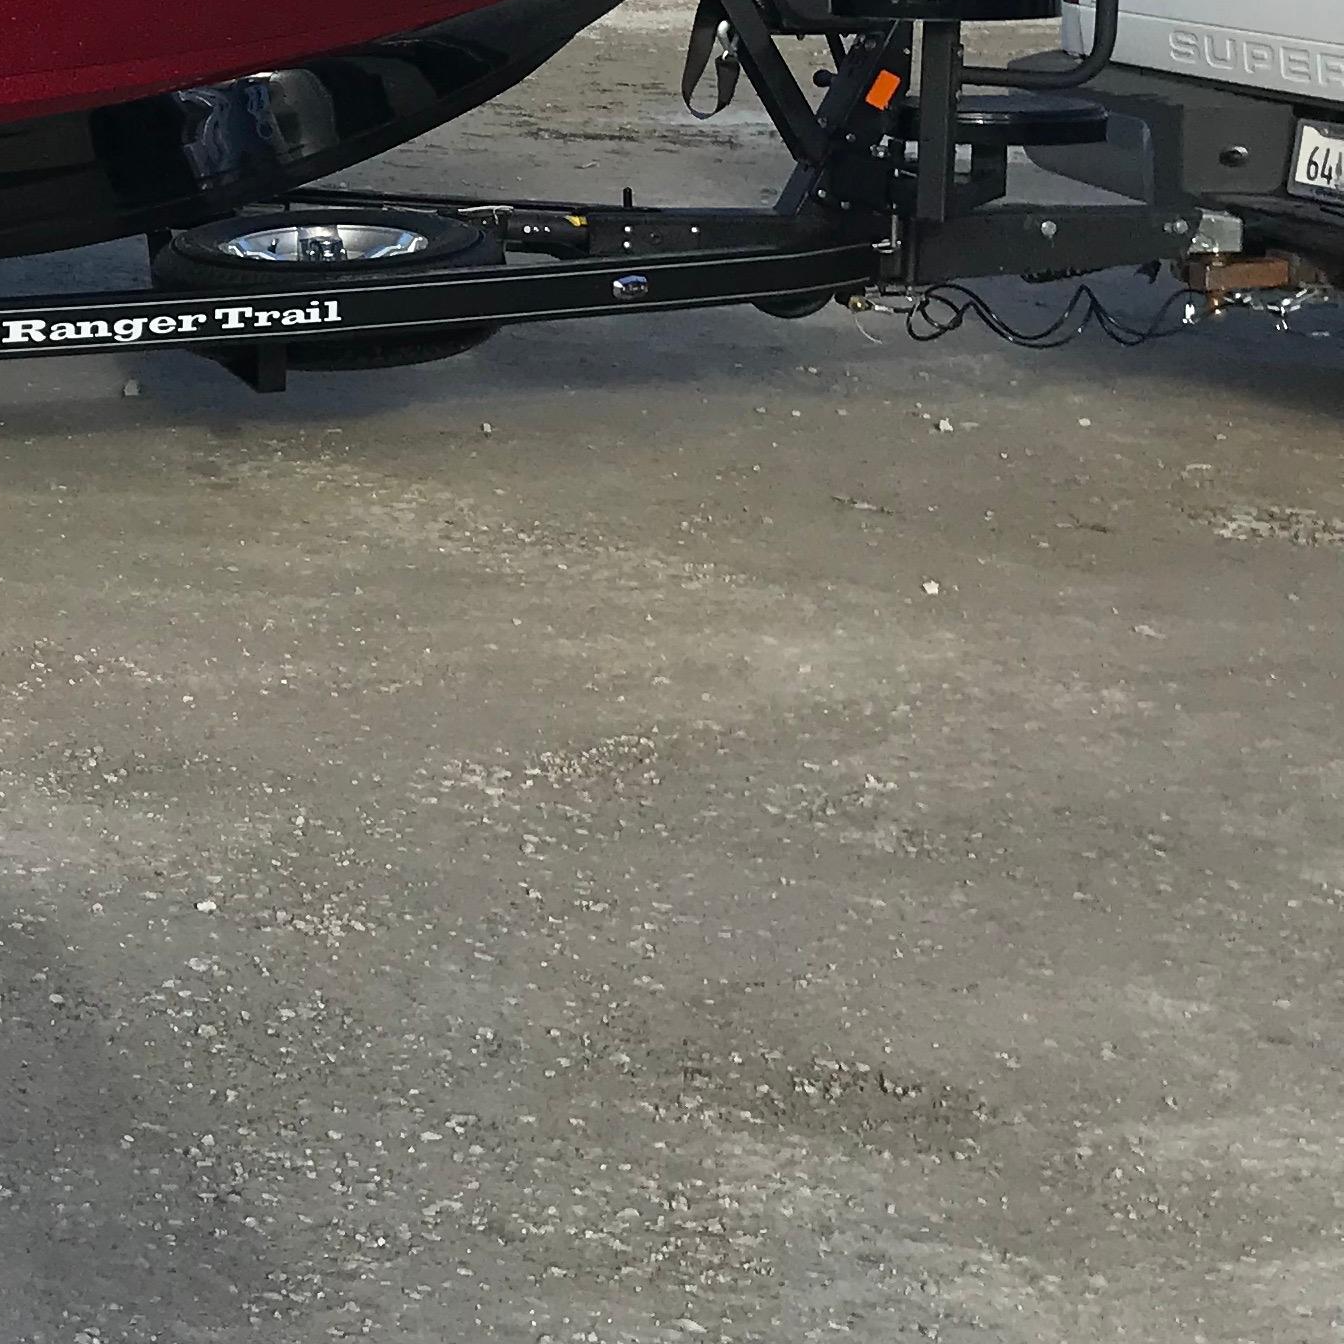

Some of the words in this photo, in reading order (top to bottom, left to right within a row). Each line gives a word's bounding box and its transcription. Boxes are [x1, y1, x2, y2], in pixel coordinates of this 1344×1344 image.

[1169, 30, 1344, 87] SUPER
[2, 313, 207, 343] Ranger
[214, 300, 342, 329] Trail
